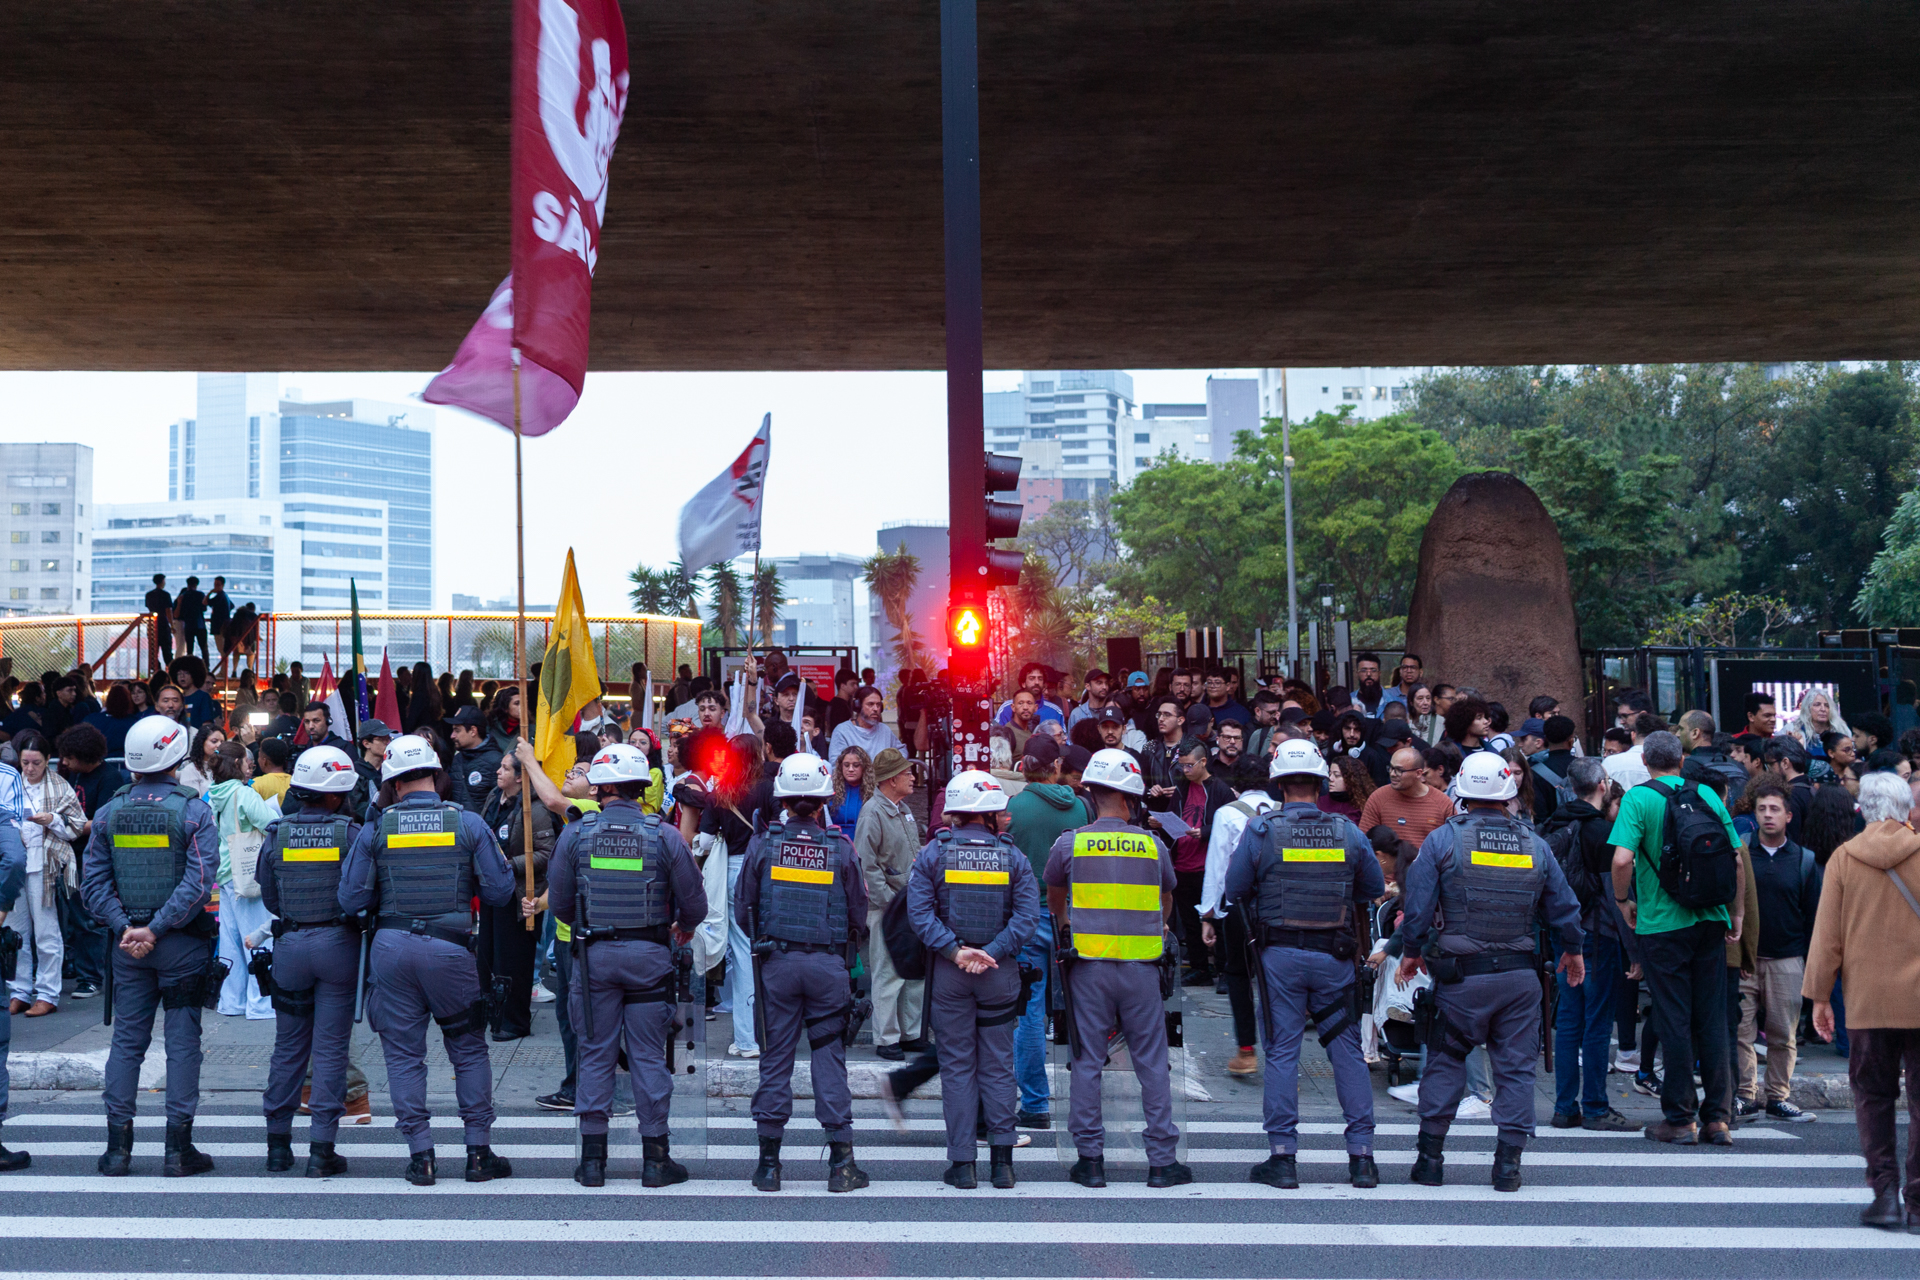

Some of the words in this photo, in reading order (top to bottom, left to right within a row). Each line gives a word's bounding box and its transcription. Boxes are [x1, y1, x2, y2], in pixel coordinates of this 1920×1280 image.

[116, 811, 166, 824] POLÍCIA
[400, 812, 441, 823] POLÍCIA
[115, 824, 167, 835] MILITAR
[290, 825, 333, 837] POLÍCIA
[400, 823, 441, 832] MILITAR
[1291, 826, 1333, 837] POLÍCIA
[596, 836, 638, 847] POLÍCIA
[1480, 831, 1519, 842] POLÍCIA
[290, 837, 332, 848] MILITAR
[1087, 837, 1147, 853] POLÍCIA
[1292, 838, 1334, 847] MILITAR
[1480, 841, 1520, 851] MILITAR
[596, 847, 638, 856] MILITAR
[783, 845, 825, 858] POLÍCIA
[958, 850, 999, 860] POLÍCIA
[782, 857, 824, 869] MILITAR
[958, 861, 999, 870] MILITAR
